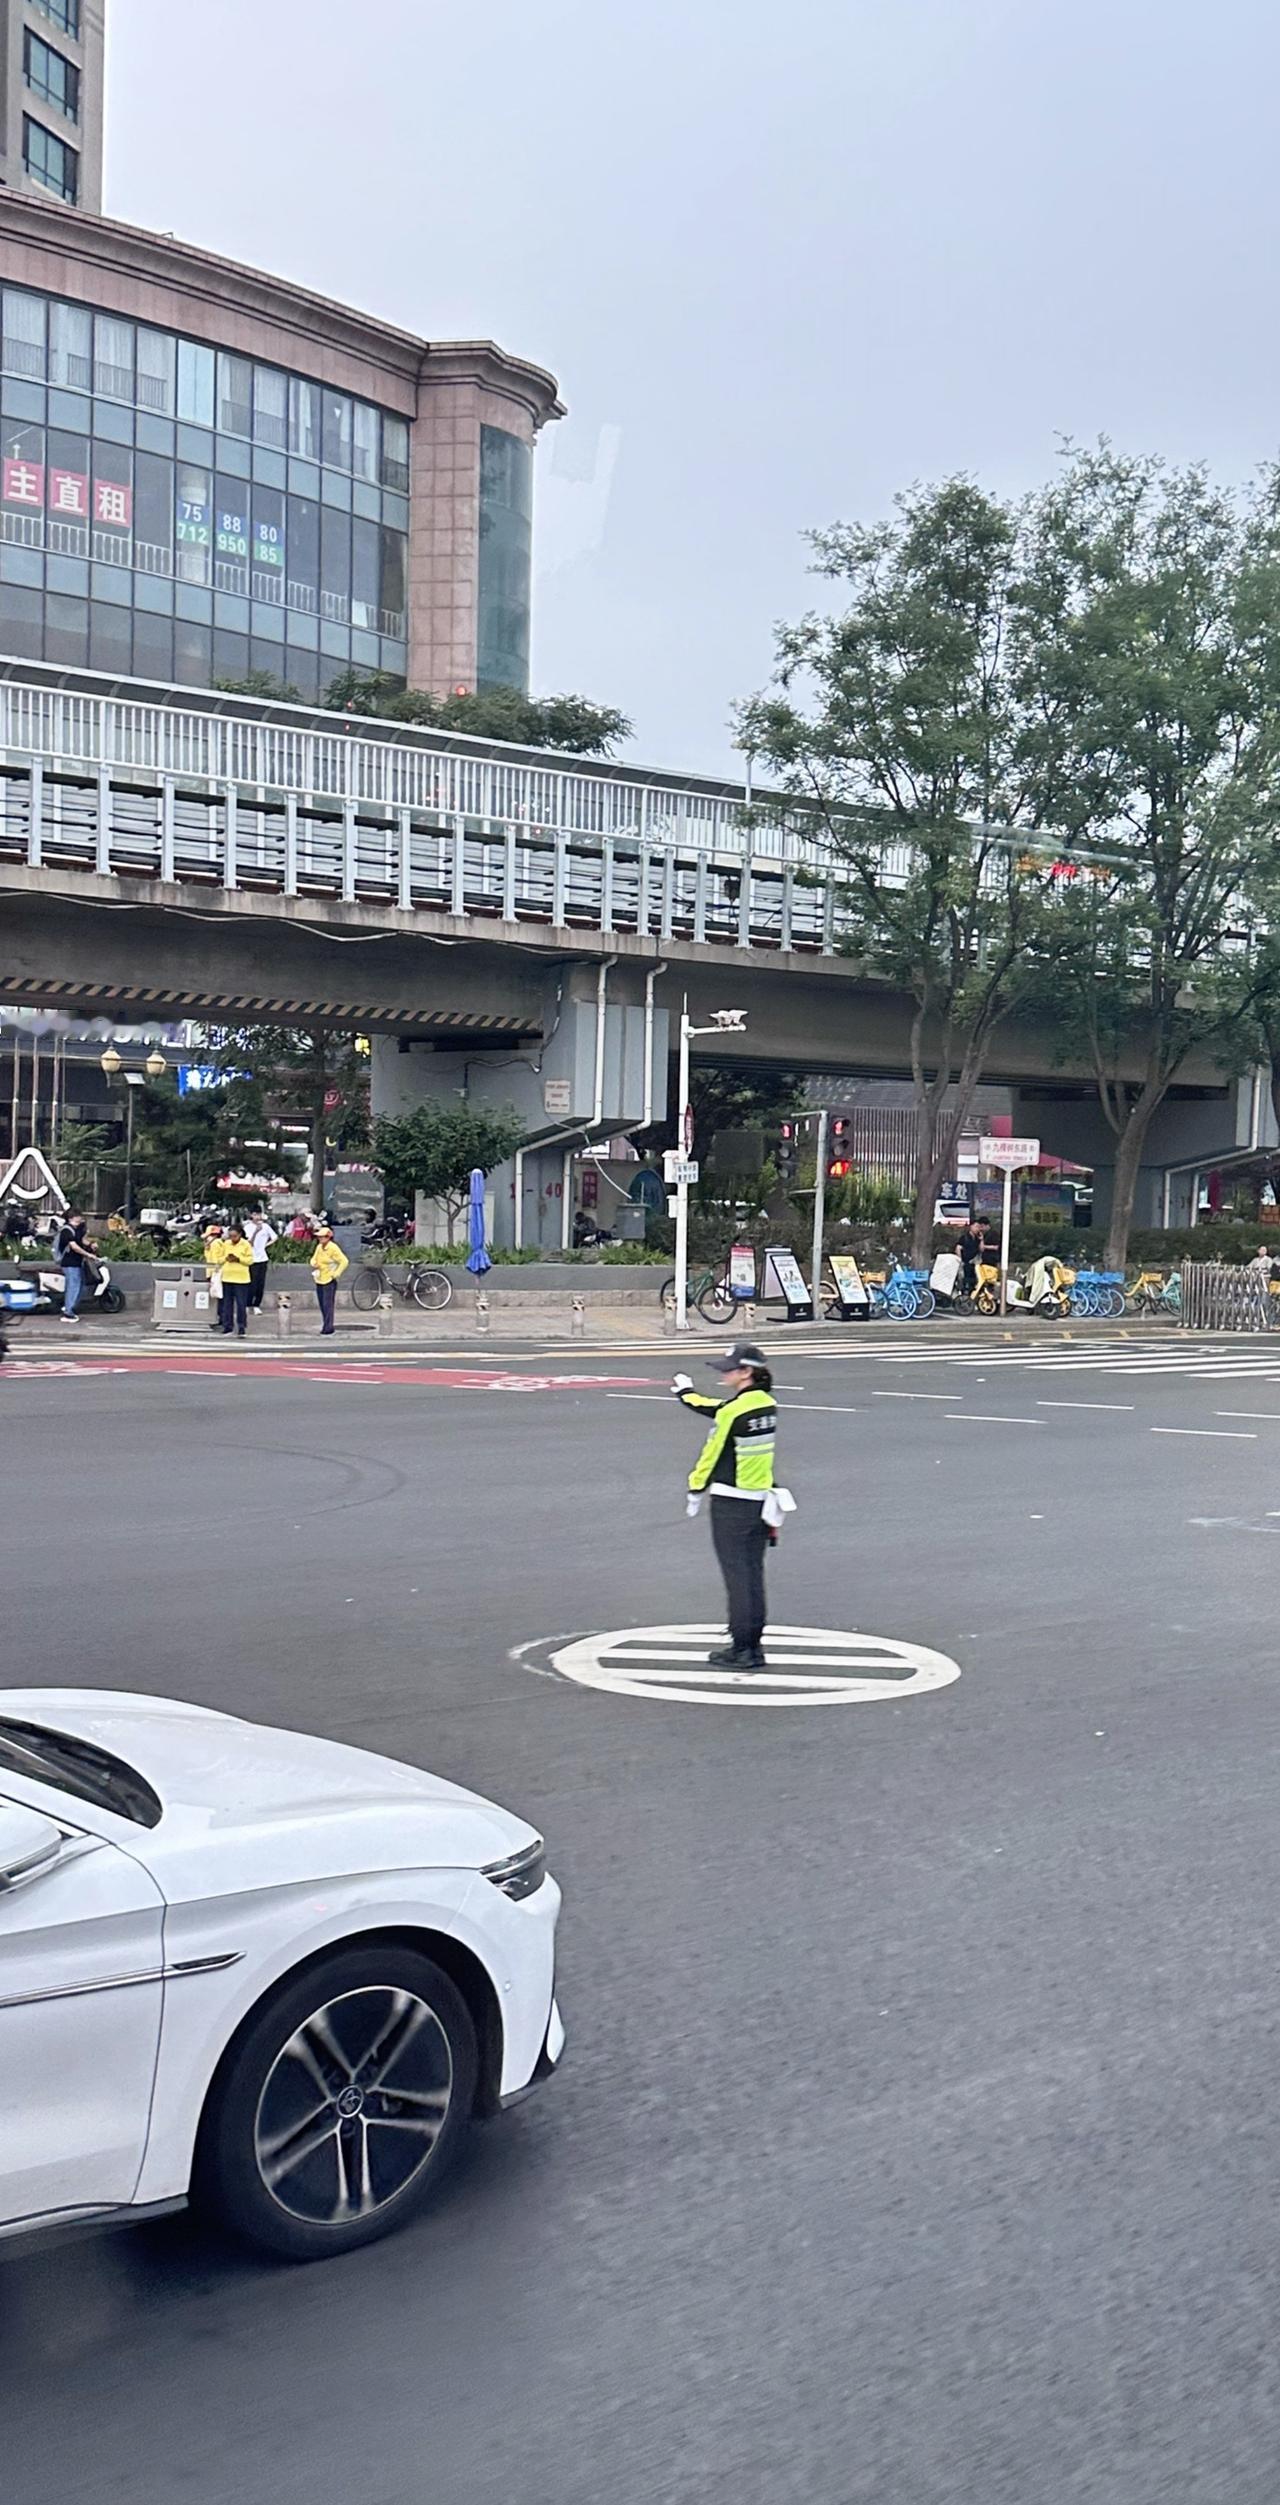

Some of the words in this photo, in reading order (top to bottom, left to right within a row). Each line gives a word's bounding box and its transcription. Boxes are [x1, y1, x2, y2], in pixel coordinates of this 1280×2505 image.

[9, 466, 127, 524] 主直租
[178, 522, 208, 545] 712
[218, 534, 246, 556] 950
[260, 545, 277, 564] 85
[182, 502, 202, 522] 75
[223, 513, 241, 533] 88
[260, 525, 277, 544] 80
